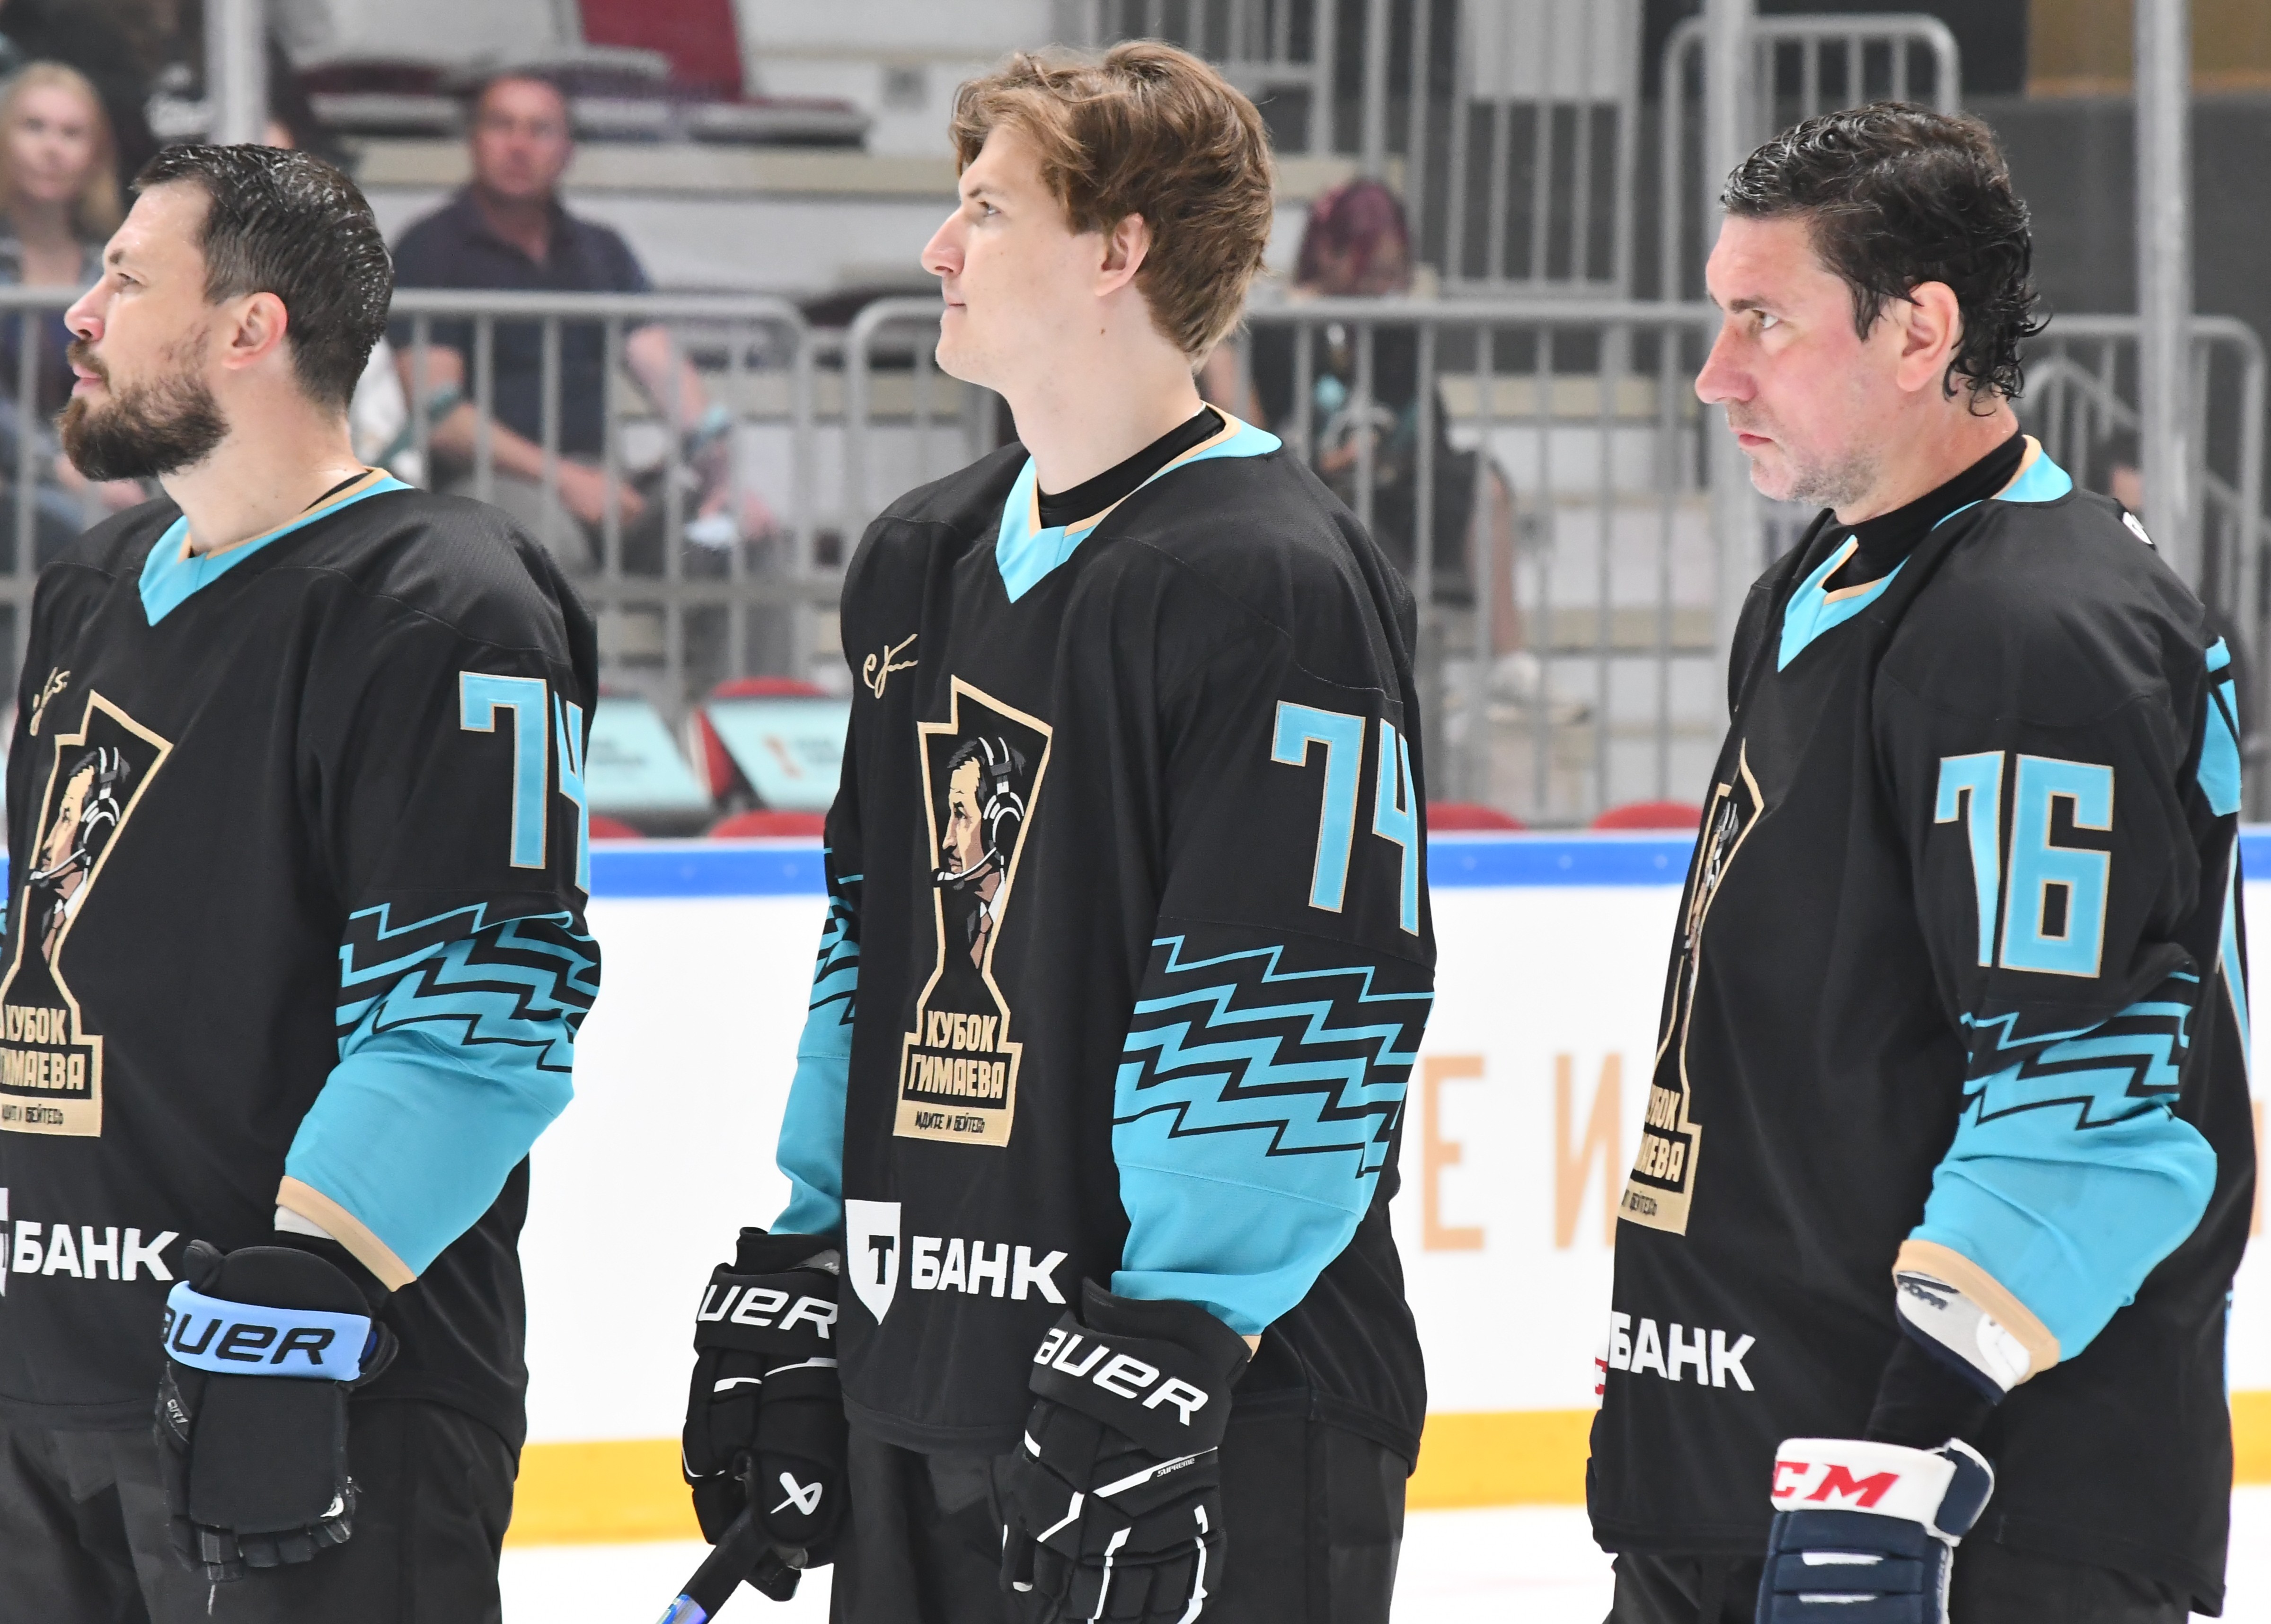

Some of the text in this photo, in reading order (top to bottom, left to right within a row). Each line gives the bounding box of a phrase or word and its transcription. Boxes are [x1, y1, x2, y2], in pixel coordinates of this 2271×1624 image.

[459, 671, 590, 895] 74
[1271, 700, 1419, 937] 74
[1934, 750, 2114, 978] 76
[925, 1010, 998, 1052] КУБОК
[0, 1047, 85, 1090] ИМАЕВА
[908, 1053, 1005, 1099] ГИМАЕВА
[13, 1220, 179, 1281] БАНК
[911, 1236, 1068, 1304] БАНК
[161, 1305, 335, 1365] AUER
[696, 1284, 838, 1339] UER
[1034, 1327, 1209, 1426] AUER
[1609, 1310, 1755, 1391] БАНК
[1772, 1461, 1900, 1508] CM
